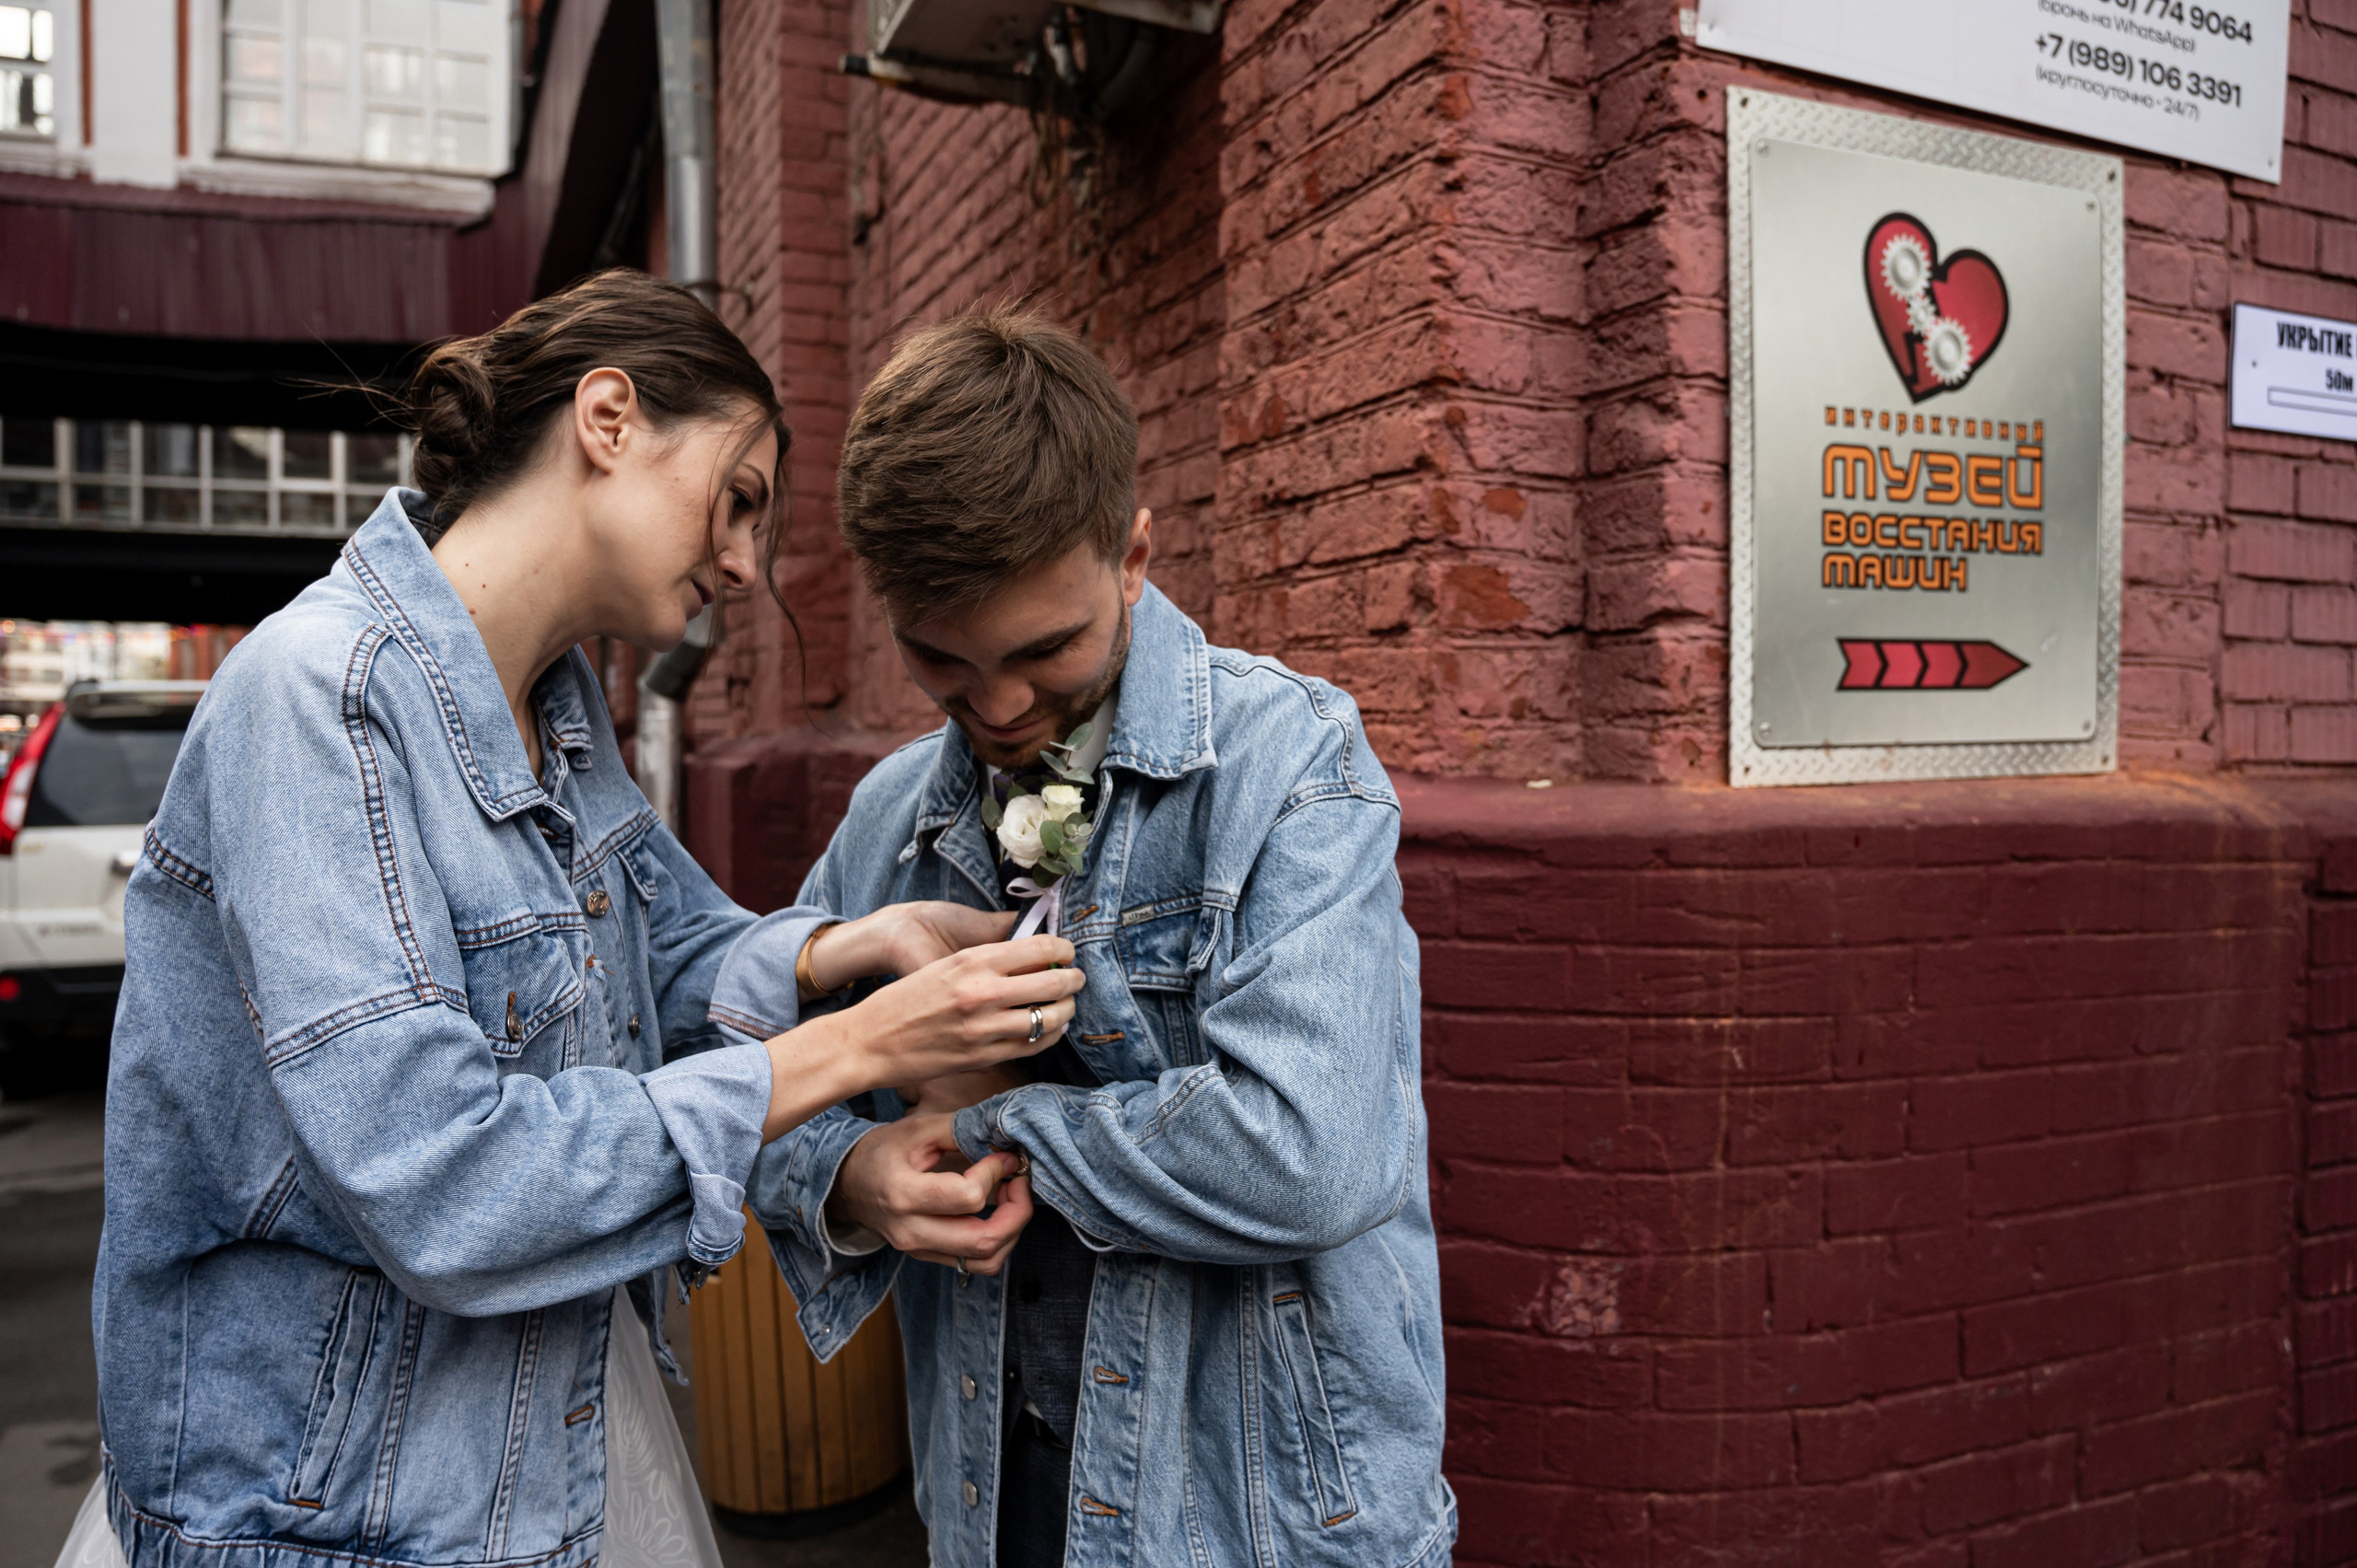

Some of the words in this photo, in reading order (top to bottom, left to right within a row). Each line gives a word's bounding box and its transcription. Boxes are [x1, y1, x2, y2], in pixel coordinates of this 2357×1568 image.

[2091, 13, 2111, 29] на
[2113, 15, 2195, 52] WhatsApp)
[2189, 6, 2252, 44] 9064
[2035, 32, 2063, 58] +7
[2068, 39, 2133, 81] (989)
[2138, 58, 2181, 91] 106
[2186, 72, 2241, 109] 3391
[2036, 63, 2154, 109] (круглосуточно
[2277, 322, 2352, 357] УКРЫТИЕ
[1822, 444, 2043, 510] МУЗЕЙ
[1822, 511, 2043, 555] ВОССТАНИЯ
[1822, 552, 1967, 591] МАШИН
